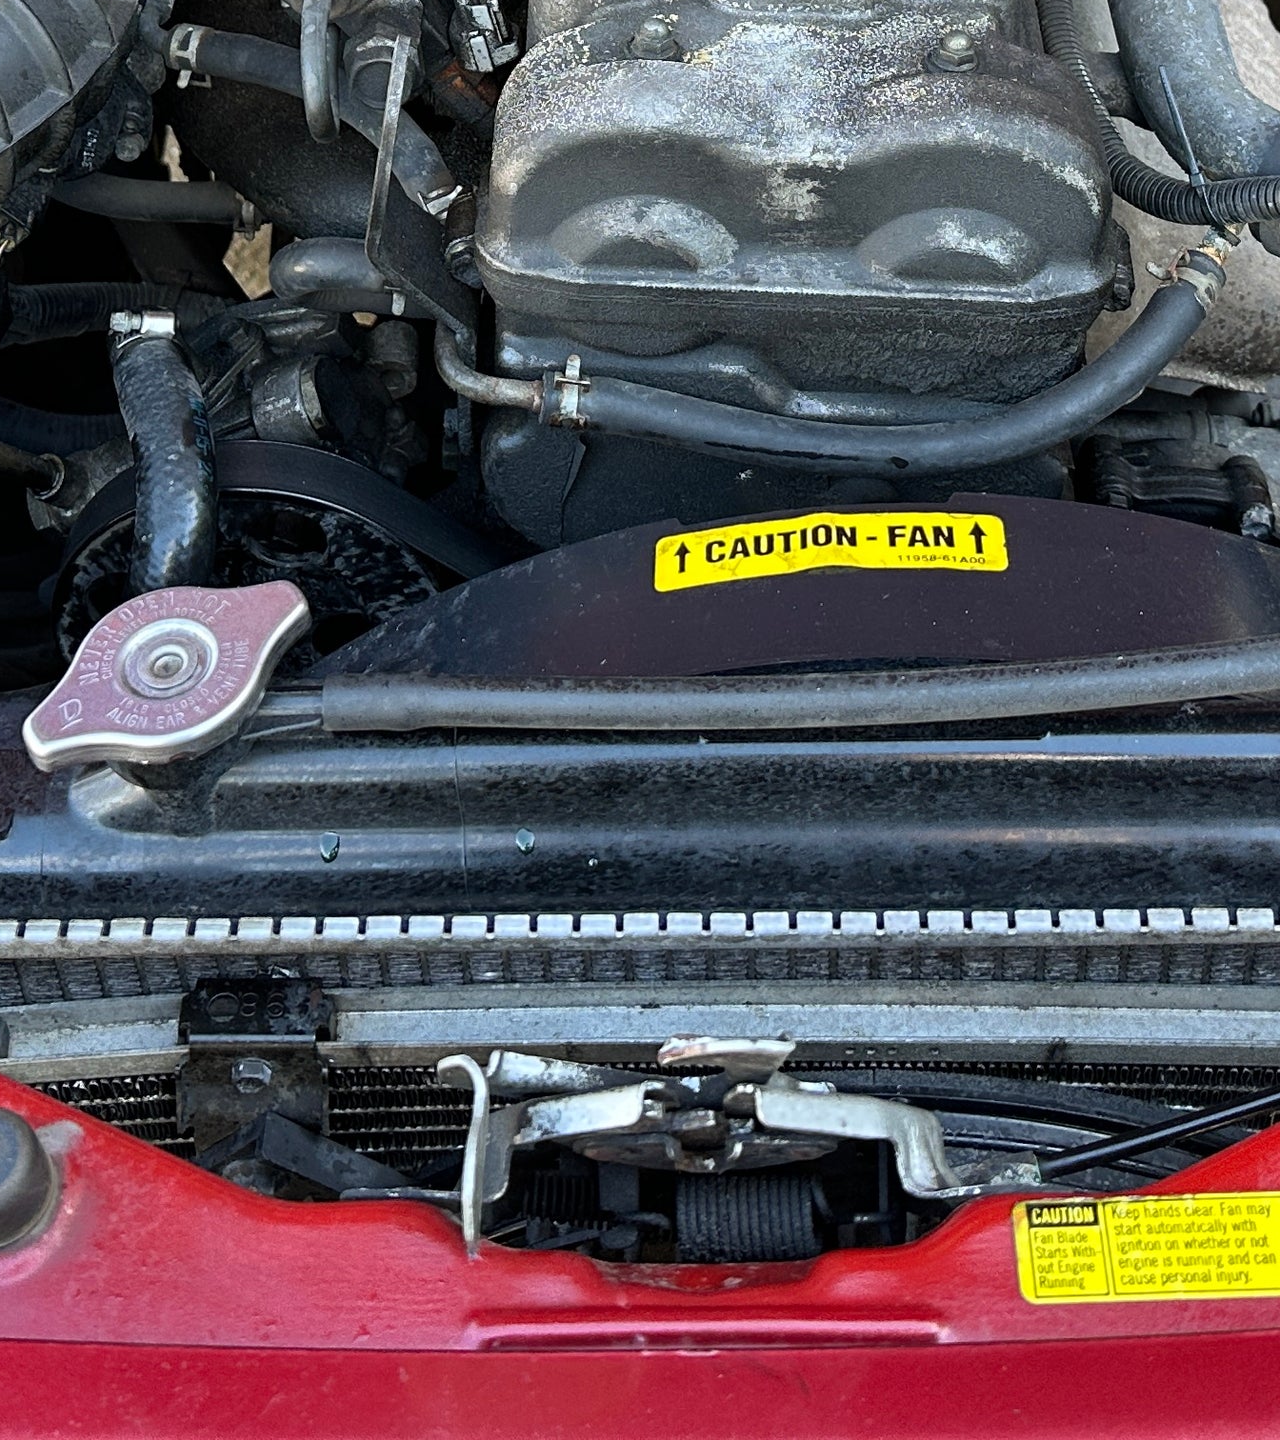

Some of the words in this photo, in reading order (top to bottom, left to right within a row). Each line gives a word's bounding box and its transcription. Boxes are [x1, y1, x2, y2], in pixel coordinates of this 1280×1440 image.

[705, 524, 857, 564] CAUTION
[887, 525, 955, 548] FAN
[79, 625, 117, 686] NEVER
[120, 591, 175, 622] OPEN
[191, 590, 231, 615] HOT
[113, 618, 146, 644] LEVEL
[106, 707, 148, 729] ALIGN
[157, 711, 186, 730] EAR
[207, 674, 240, 707] VENT
[234, 638, 250, 669] TUBE
[1032, 1206, 1095, 1225] CAUTION
[1112, 1206, 1140, 1221] Keep
[1144, 1204, 1181, 1219] hands
[1219, 1202, 1242, 1216] Fan
[1247, 1204, 1271, 1219] may
[1034, 1231, 1054, 1244] Fan
[1057, 1230, 1089, 1244] Blade
[1114, 1223, 1142, 1236] start
[1146, 1219, 1228, 1235] automatically
[1232, 1219, 1257, 1233] with
[1035, 1245, 1068, 1259] Starts
[1071, 1245, 1102, 1258] With-
[1116, 1238, 1161, 1254] ignition
[1165, 1239, 1179, 1250] on
[1184, 1236, 1231, 1251] whether
[1234, 1237, 1246, 1248] or
[1250, 1235, 1269, 1248] not
[1037, 1261, 1054, 1274] out
[1057, 1260, 1096, 1276] Engine
[1119, 1257, 1158, 1271] engine
[1163, 1255, 1173, 1267] is
[1176, 1254, 1224, 1269] running
[1228, 1251, 1250, 1265] and
[1254, 1252, 1276, 1265] can
[1039, 1276, 1086, 1291] Running
[1120, 1272, 1157, 1285] cause
[1161, 1269, 1212, 1286] personal
[1216, 1270, 1252, 1285] injury.
